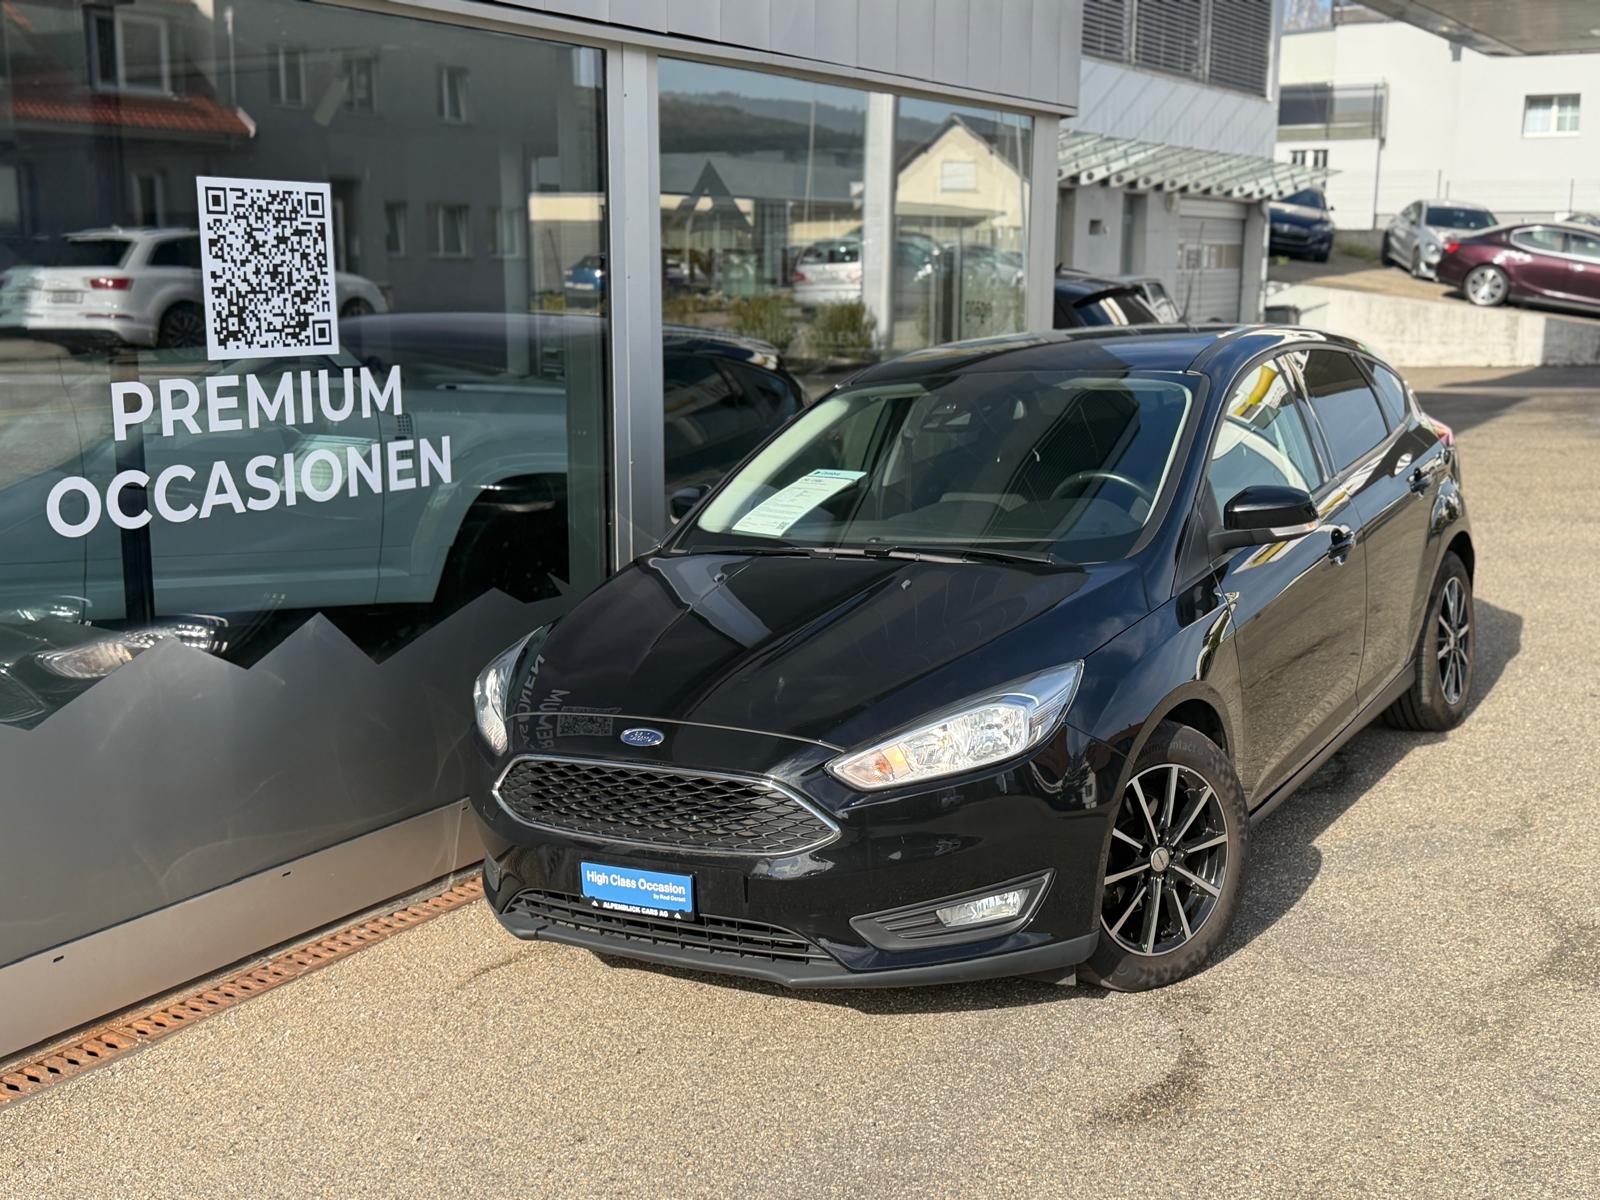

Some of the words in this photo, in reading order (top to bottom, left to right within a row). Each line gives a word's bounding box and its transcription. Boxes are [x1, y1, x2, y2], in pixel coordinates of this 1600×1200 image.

[111, 365, 404, 441] PREMIUM
[46, 436, 453, 539] OCCASIONEN
[586, 870, 608, 885] High
[610, 874, 636, 889] Class
[638, 878, 686, 895] Occasion
[641, 907, 658, 917] CARS
